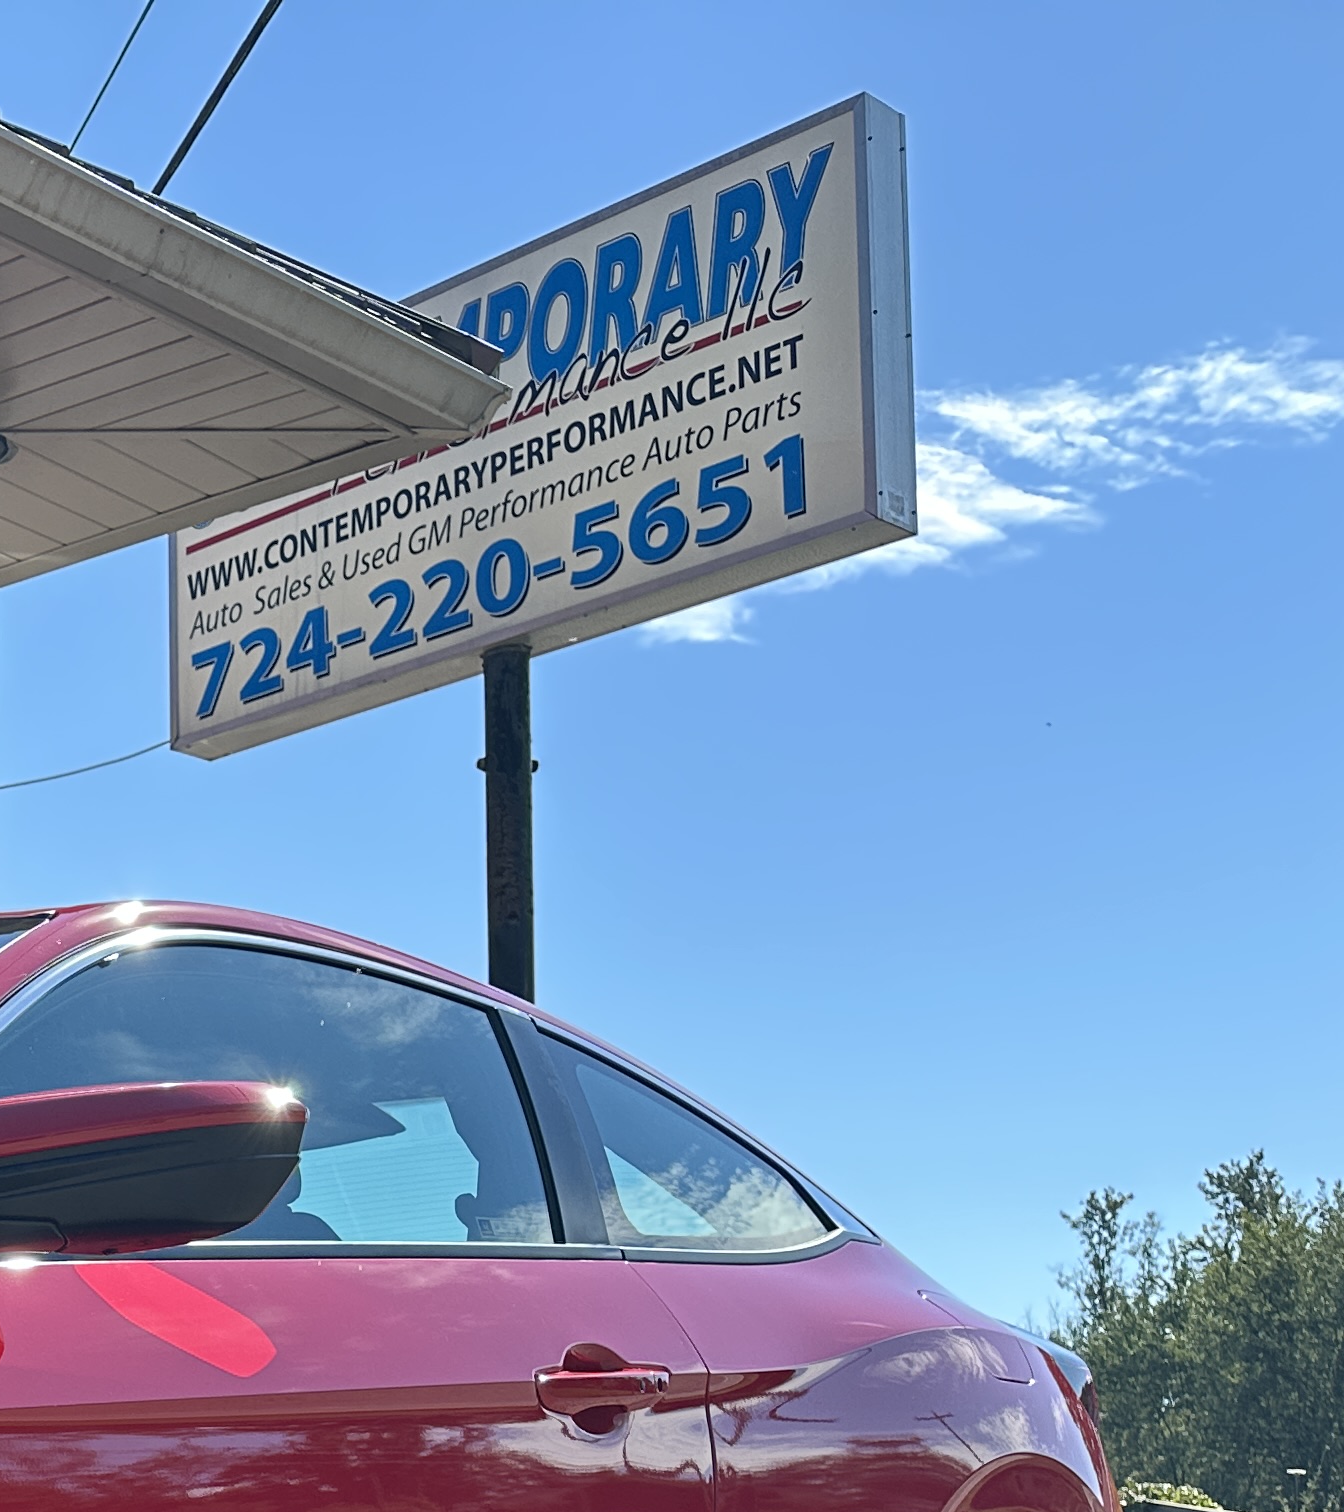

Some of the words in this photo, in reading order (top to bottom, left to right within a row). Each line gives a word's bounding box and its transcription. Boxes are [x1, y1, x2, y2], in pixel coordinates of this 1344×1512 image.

[186, 333, 804, 600] WWW.CONTEMPORARYPERFORMANCE.NET
[189, 601, 243, 640] Auto
[253, 575, 312, 616] Sales
[317, 560, 336, 590] &
[342, 531, 402, 581] Used
[407, 514, 452, 556] GM
[458, 452, 635, 540] Performance
[641, 423, 715, 472] Auto
[722, 390, 803, 442] Parts
[190, 433, 807, 720] 724-220-5651
